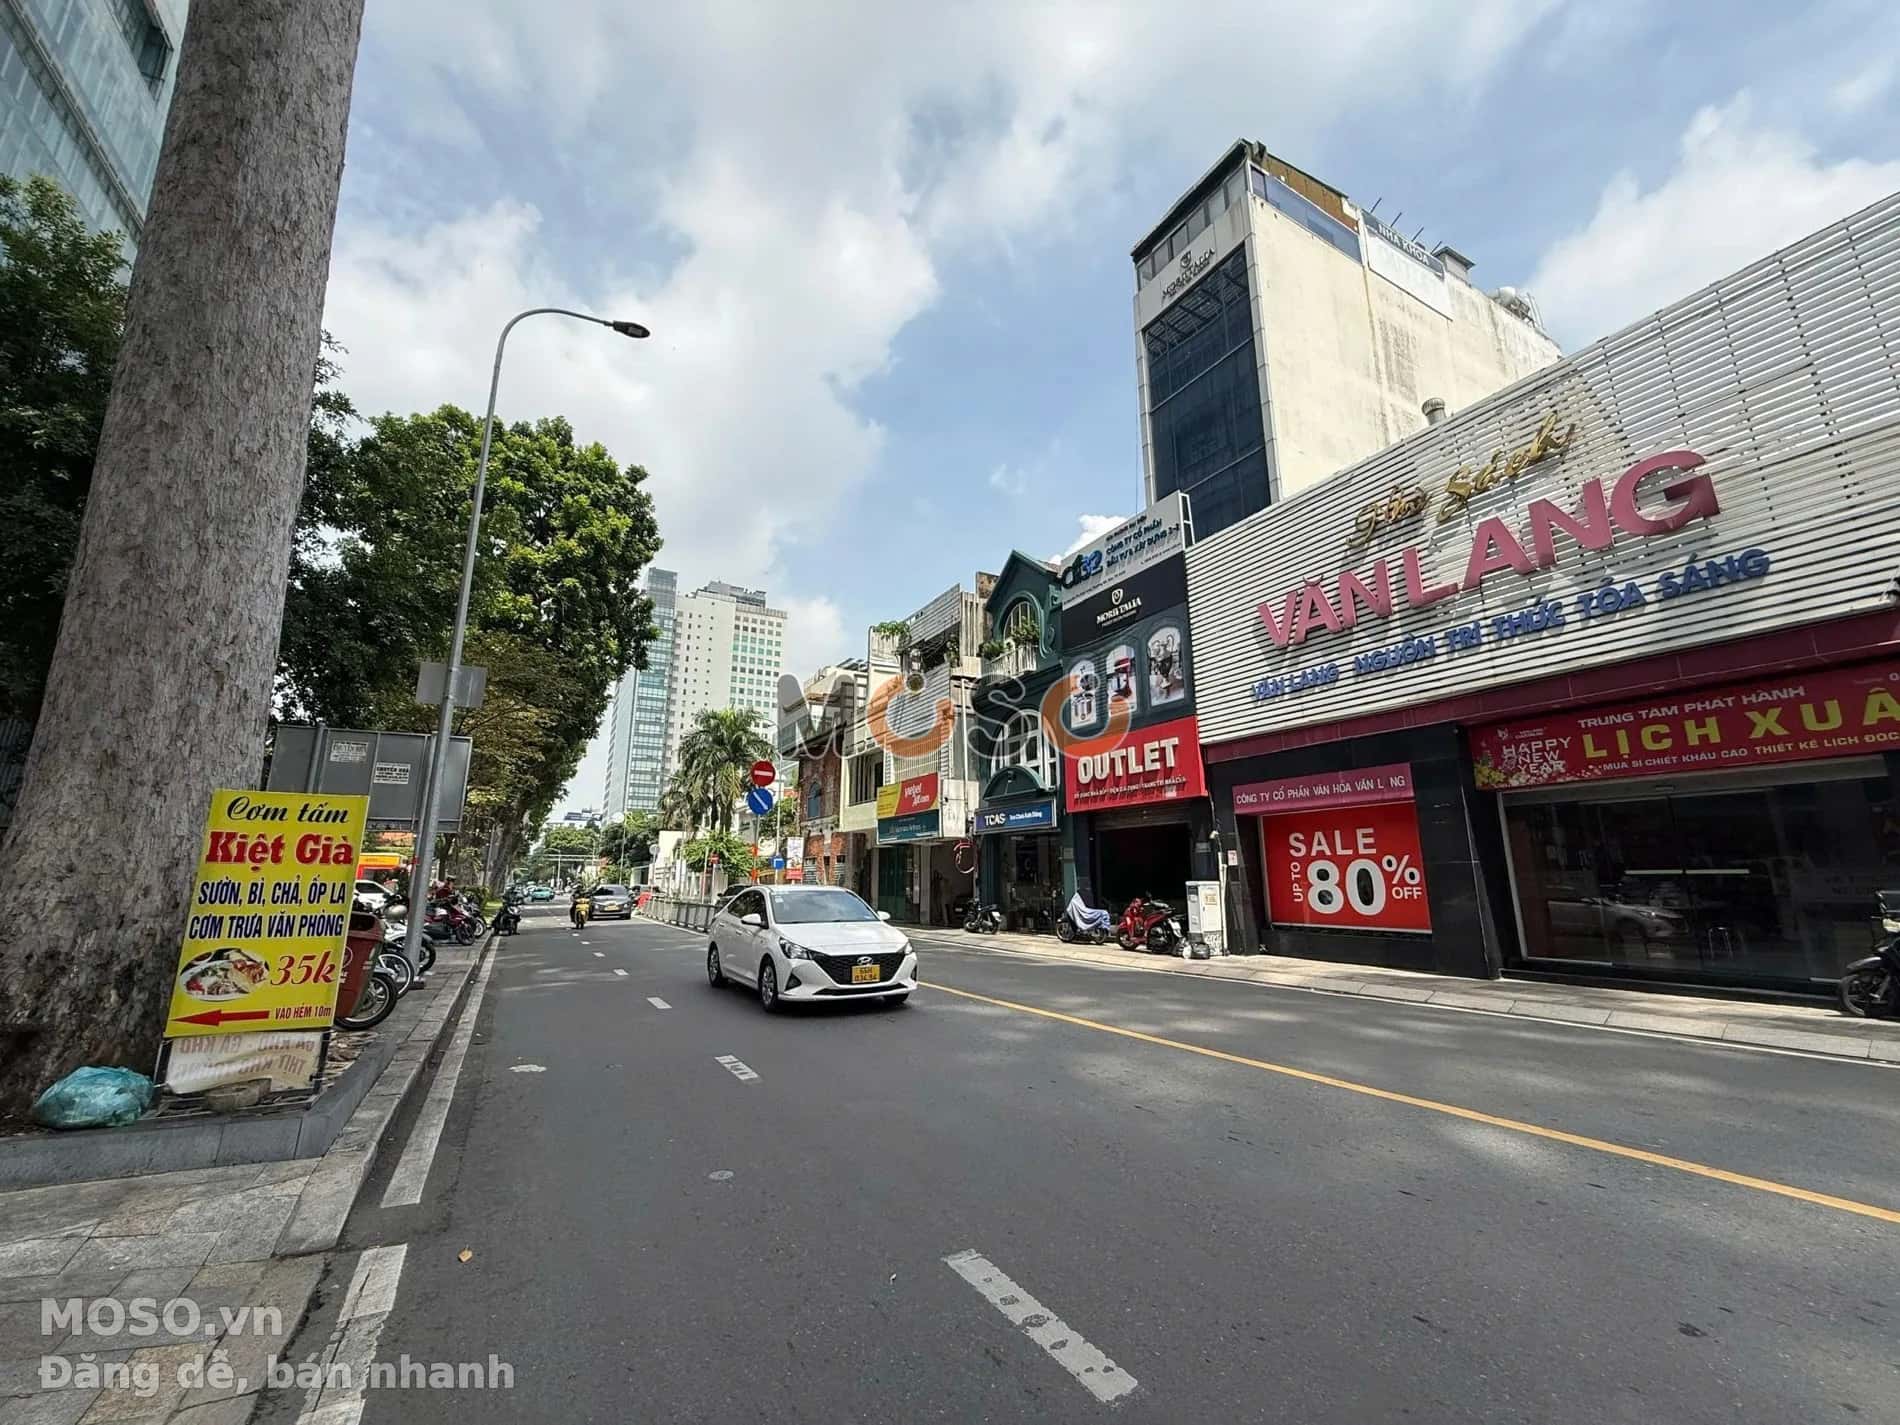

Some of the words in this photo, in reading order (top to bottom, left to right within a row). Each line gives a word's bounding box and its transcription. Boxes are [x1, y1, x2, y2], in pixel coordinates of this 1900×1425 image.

[1289, 663, 1340, 690] LANG
[1493, 596, 1566, 639] THỨC
[1657, 549, 1770, 600] SÁNG
[1578, 712, 1634, 729] TRUNG
[1502, 736, 1572, 757] HAPPY
[1582, 717, 1721, 759] LỊCH
[1077, 737, 1179, 784] OUTLET
[1518, 750, 1560, 764] NEW
[1721, 748, 1748, 759] CAO
[1517, 760, 1566, 775] YEAR
[1259, 792, 1270, 801] TY
[227, 796, 288, 821] Cơm
[297, 802, 349, 823] tấm
[984, 813, 1006, 826] TCAS
[205, 831, 286, 872] Kiệt
[295, 833, 354, 865] Già
[1288, 827, 1377, 858] SALE
[1290, 862, 1302, 882] TO
[198, 876, 243, 907] SƯỜN,
[247, 876, 266, 907] BÌ,
[271, 874, 302, 907] CHẢ,
[307, 874, 327, 905] ỐP
[329, 882, 346, 905] LA
[1292, 883, 1304, 902] UP
[1391, 886, 1422, 900] OFF
[188, 913, 223, 940] CƠM
[227, 912, 263, 939] TRƯA
[267, 910, 296, 938] VĂN
[297, 909, 345, 937] PHÒNG
[270, 950, 336, 986] 35k
[314, 1006, 332, 1017] 10m
